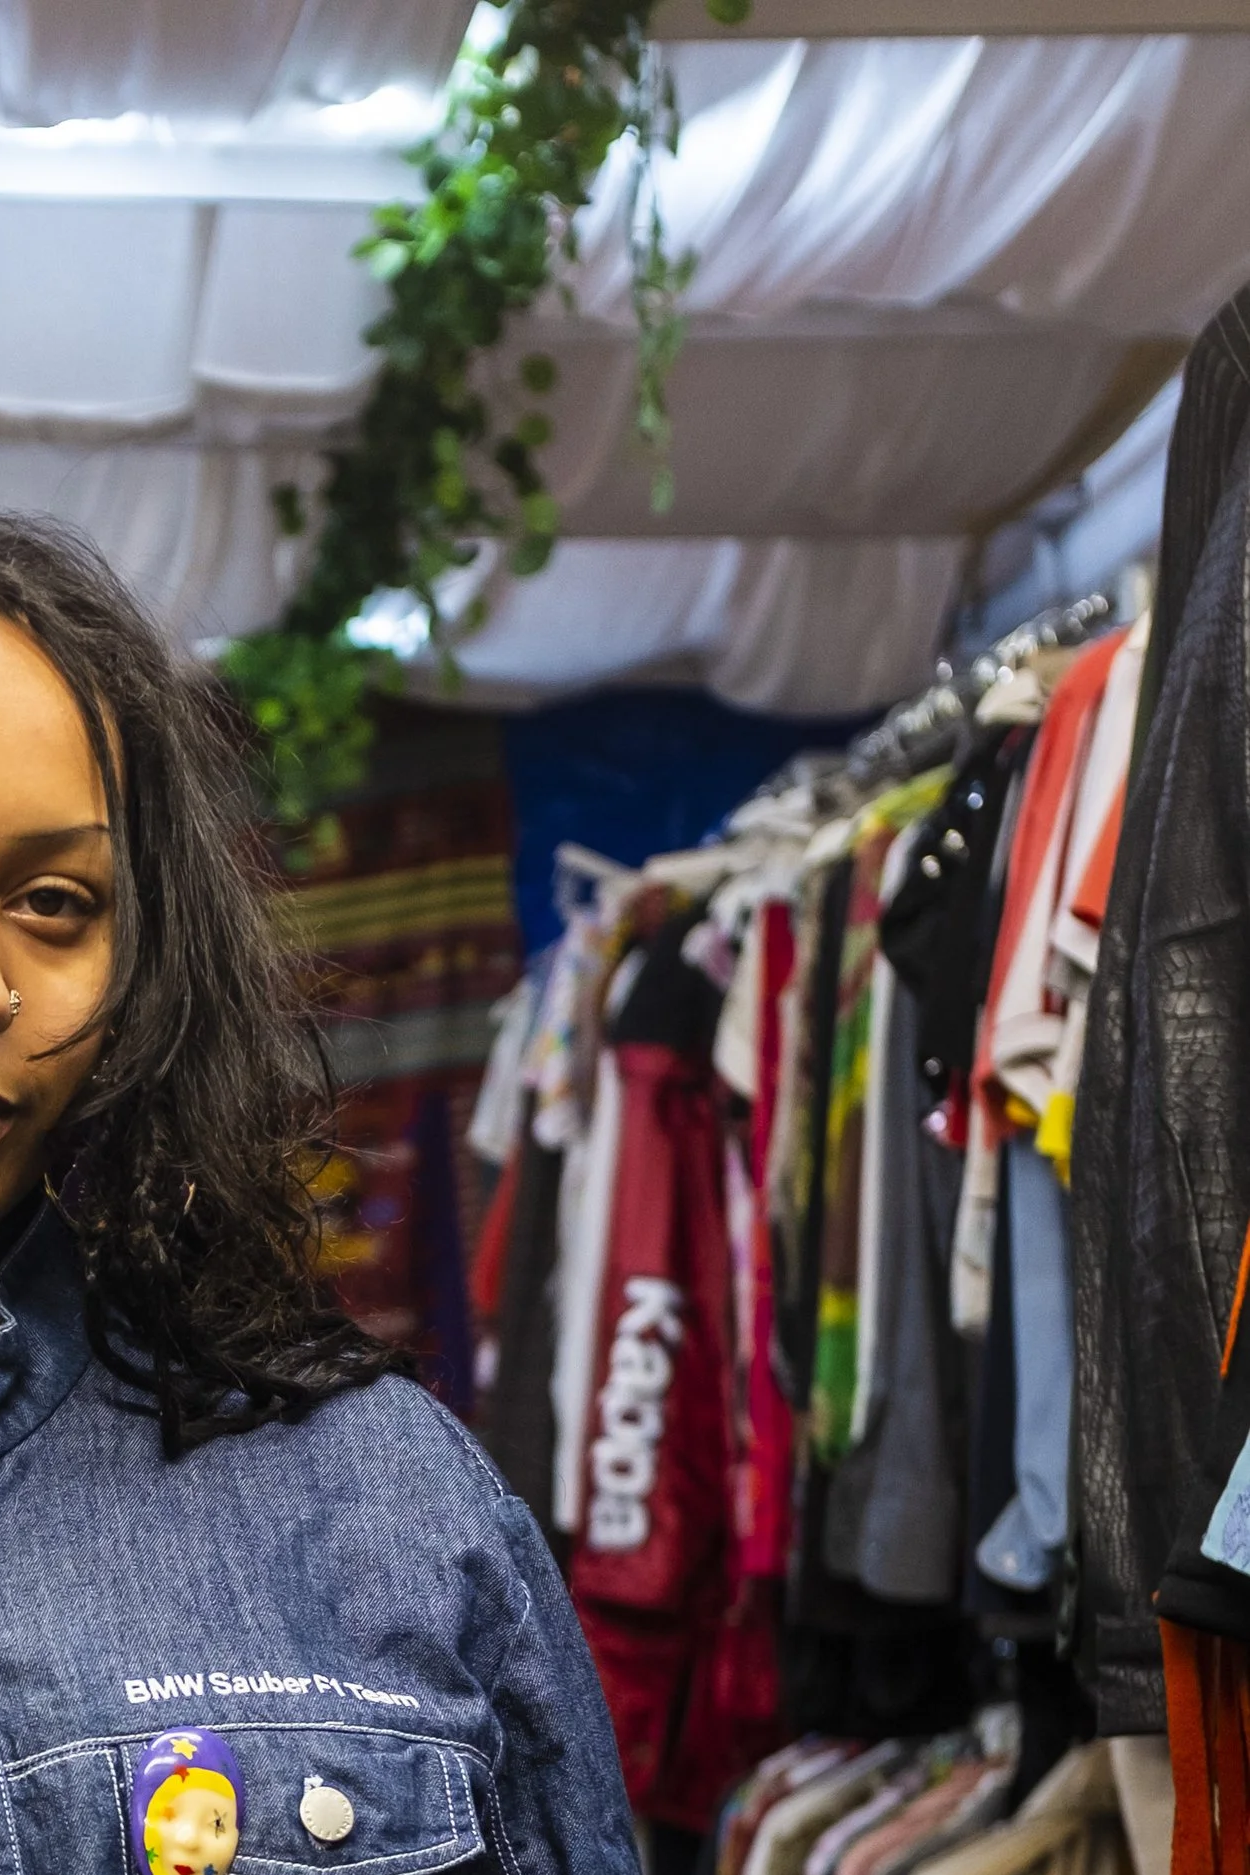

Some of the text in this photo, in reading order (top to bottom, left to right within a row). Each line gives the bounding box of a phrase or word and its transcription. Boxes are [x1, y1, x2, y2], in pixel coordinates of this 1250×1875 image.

[124, 1670, 420, 1709] BMW Sauber F1 Team
